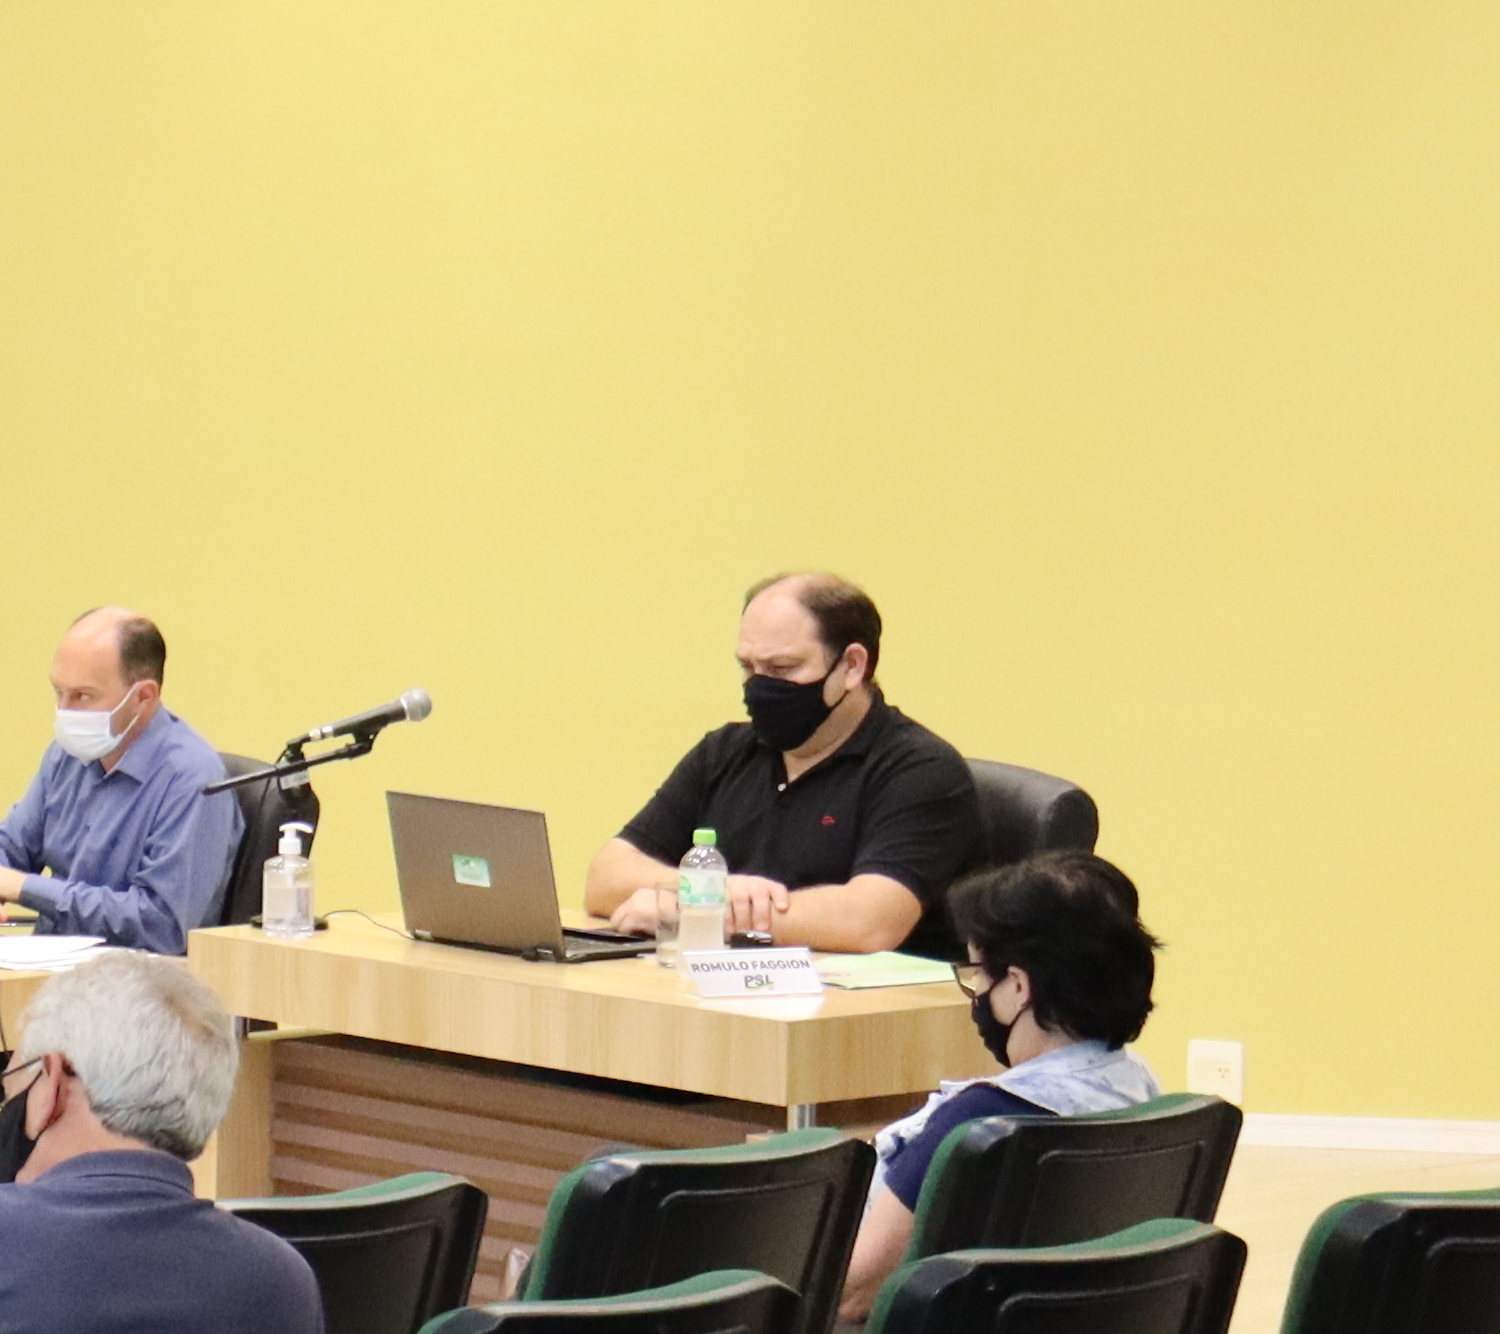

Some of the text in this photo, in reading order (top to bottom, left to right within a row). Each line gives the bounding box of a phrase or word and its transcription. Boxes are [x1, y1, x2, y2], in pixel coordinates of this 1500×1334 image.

[690, 959, 811, 973] ROMULO FAGGION
[744, 974, 774, 988] PSL
